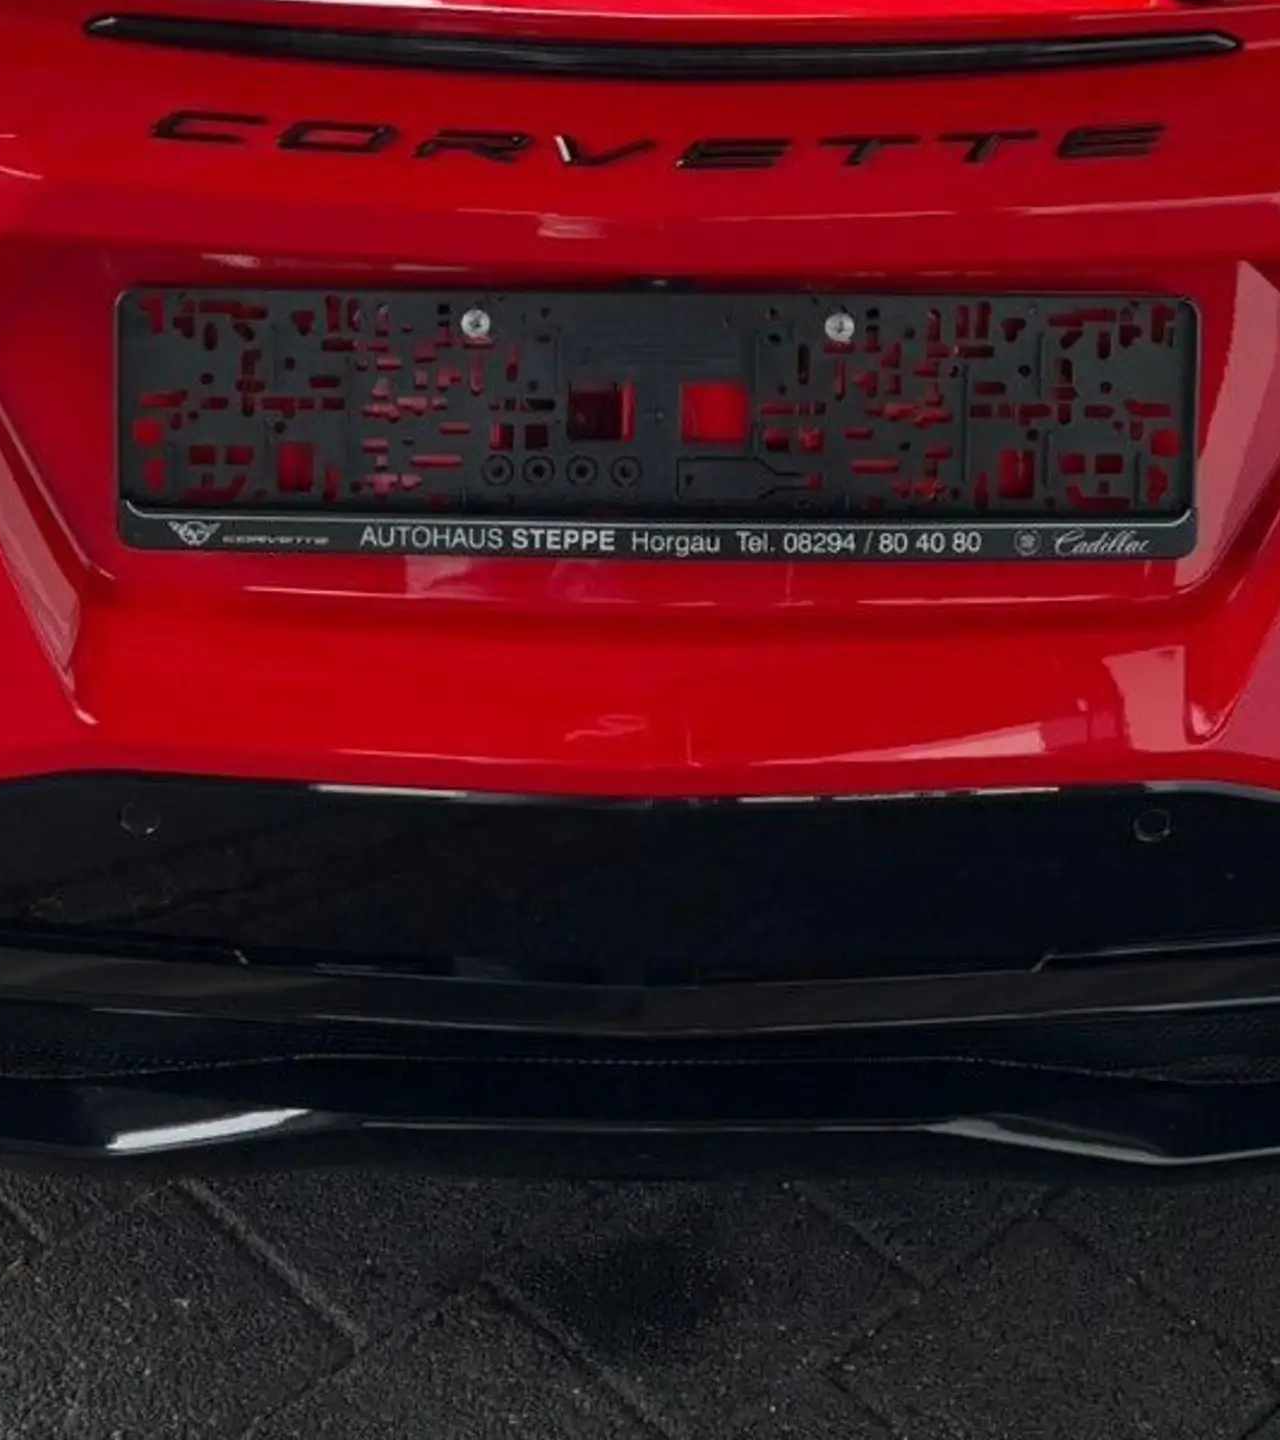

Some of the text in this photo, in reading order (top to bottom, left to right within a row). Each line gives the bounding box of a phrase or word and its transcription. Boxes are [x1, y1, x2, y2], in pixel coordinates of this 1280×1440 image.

[150, 109, 1167, 171] CORVETTE
[359, 526, 982, 558] AUTOHAUS STEPPE Horgau Tel. 08294 / 80 40 80
[1053, 527, 1152, 557] Cadillac
